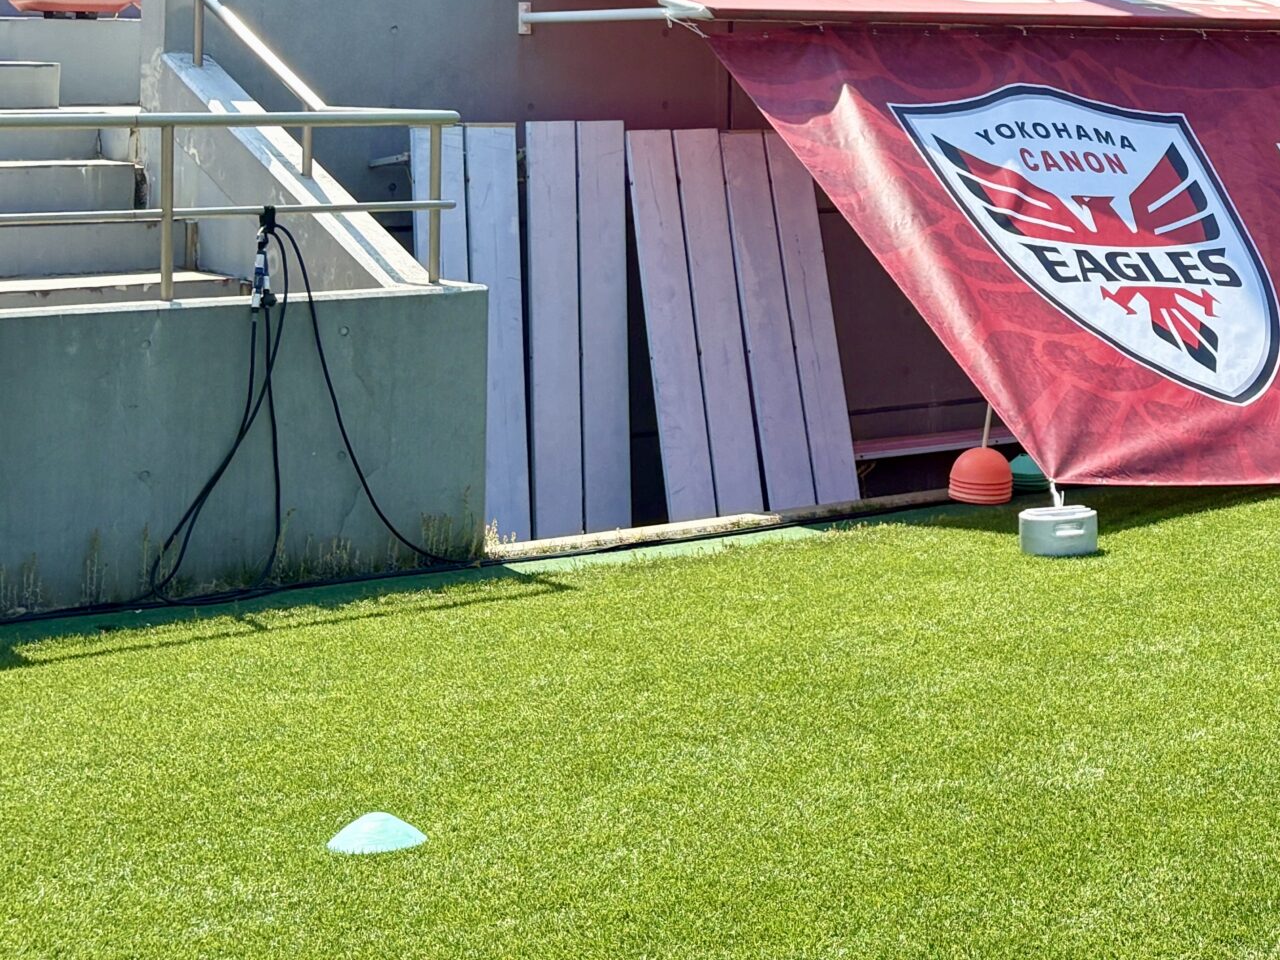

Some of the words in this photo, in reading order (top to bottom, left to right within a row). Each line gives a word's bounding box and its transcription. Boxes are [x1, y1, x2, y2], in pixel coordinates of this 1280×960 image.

[974, 121, 1138, 152] YOKOHAMA
[1019, 147, 1128, 175] CANON
[1018, 243, 1242, 287] EAGLES
